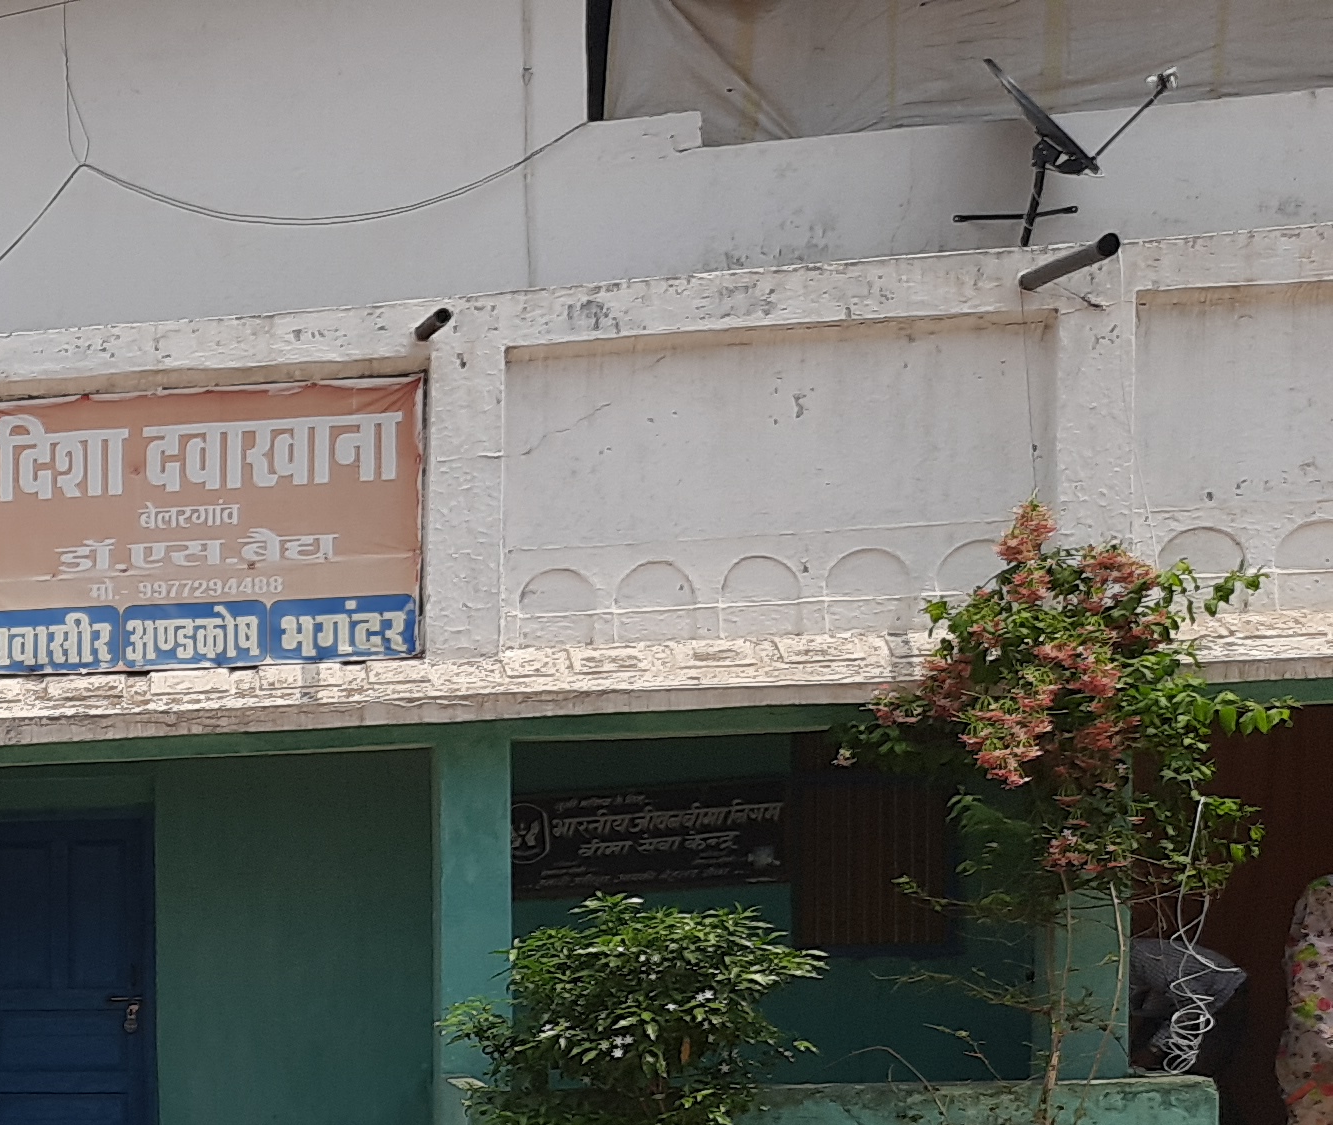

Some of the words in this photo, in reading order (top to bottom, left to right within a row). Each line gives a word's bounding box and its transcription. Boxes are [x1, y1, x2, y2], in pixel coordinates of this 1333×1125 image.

[142, 411, 404, 493] दवाखाना
[137, 499, 241, 530] बेलरगांव
[137, 576, 284, 599] 9977294488
[125, 606, 259, 661] अण्डकोष
[280, 600, 408, 657] भगंदर
